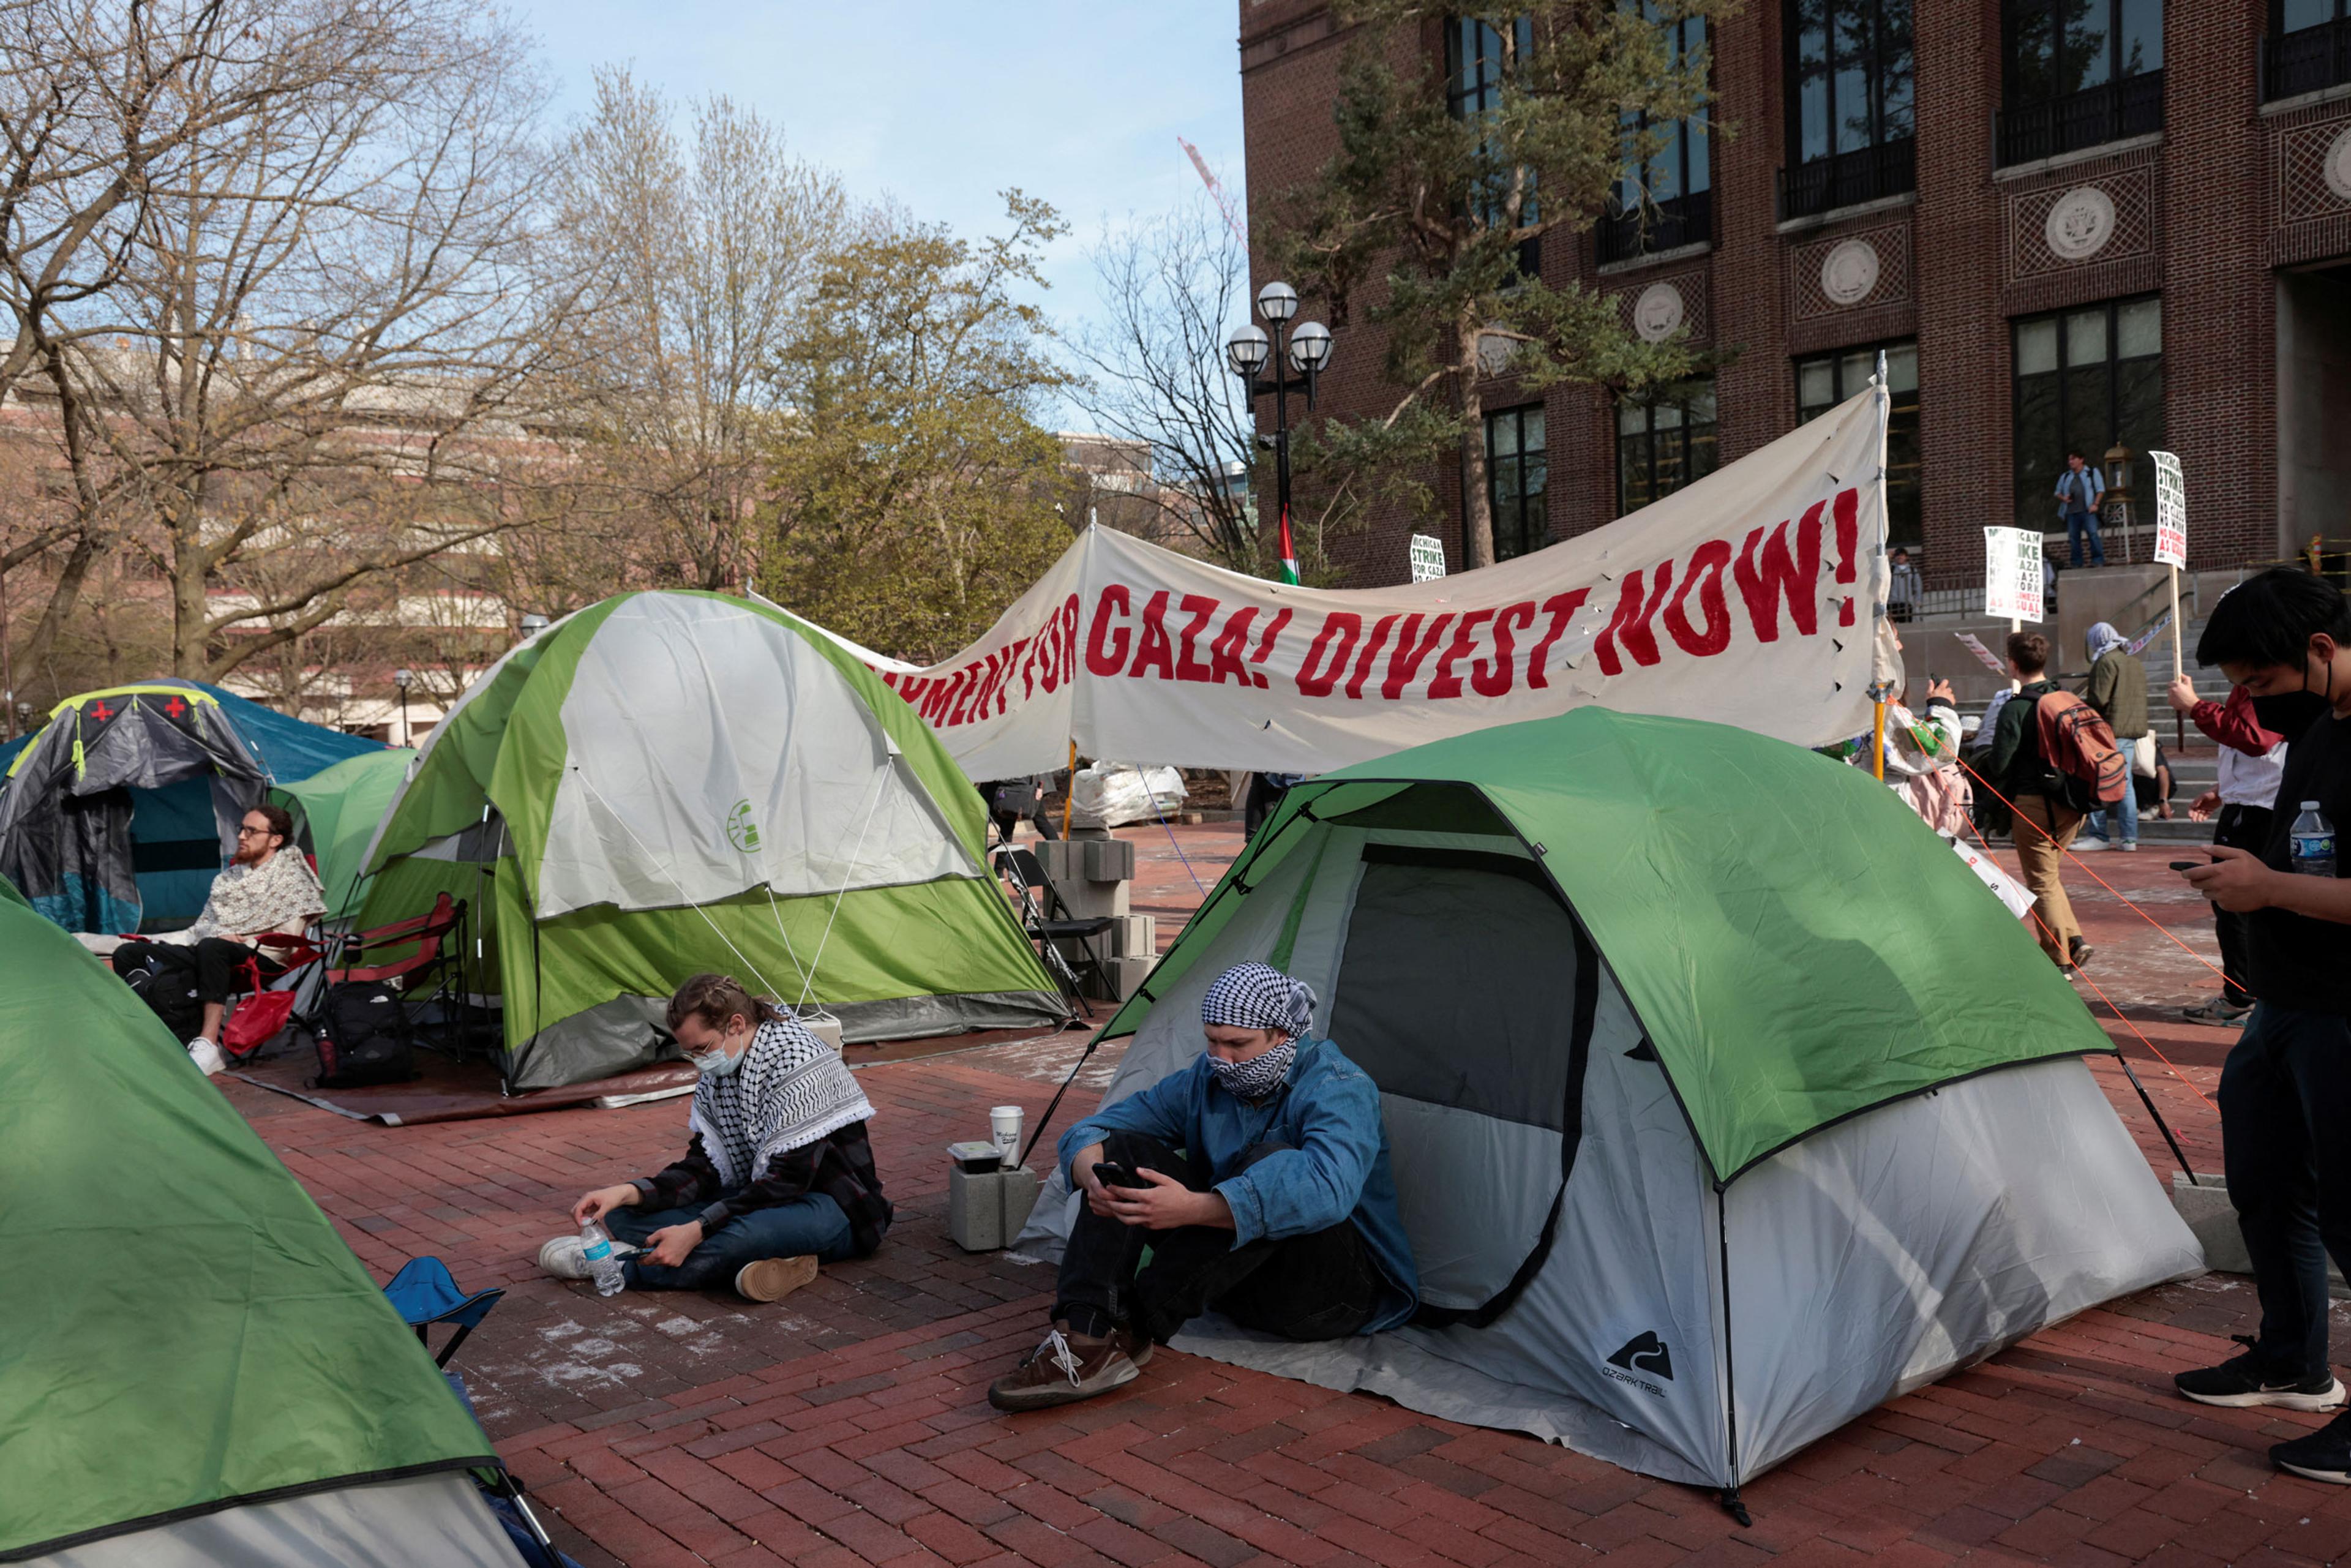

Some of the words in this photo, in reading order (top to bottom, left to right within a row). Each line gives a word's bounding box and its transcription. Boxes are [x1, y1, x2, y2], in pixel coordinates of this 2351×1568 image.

[2159, 467, 2182, 494] STRIKE
[2159, 487, 2170, 502] FOR
[2160, 501, 2167, 514] NO
[2160, 515, 2168, 527] NO
[2159, 539, 2169, 552] AS
[1412, 548, 1443, 566] STRIKE
[1414, 563, 1426, 574] FOR
[1428, 565, 1444, 576] GAZA
[1023, 593, 1079, 701] FOR
[1086, 584, 1292, 689] GAZA!
[1295, 587, 1591, 699] DIVEST
[1593, 488, 1859, 675] NOW!
